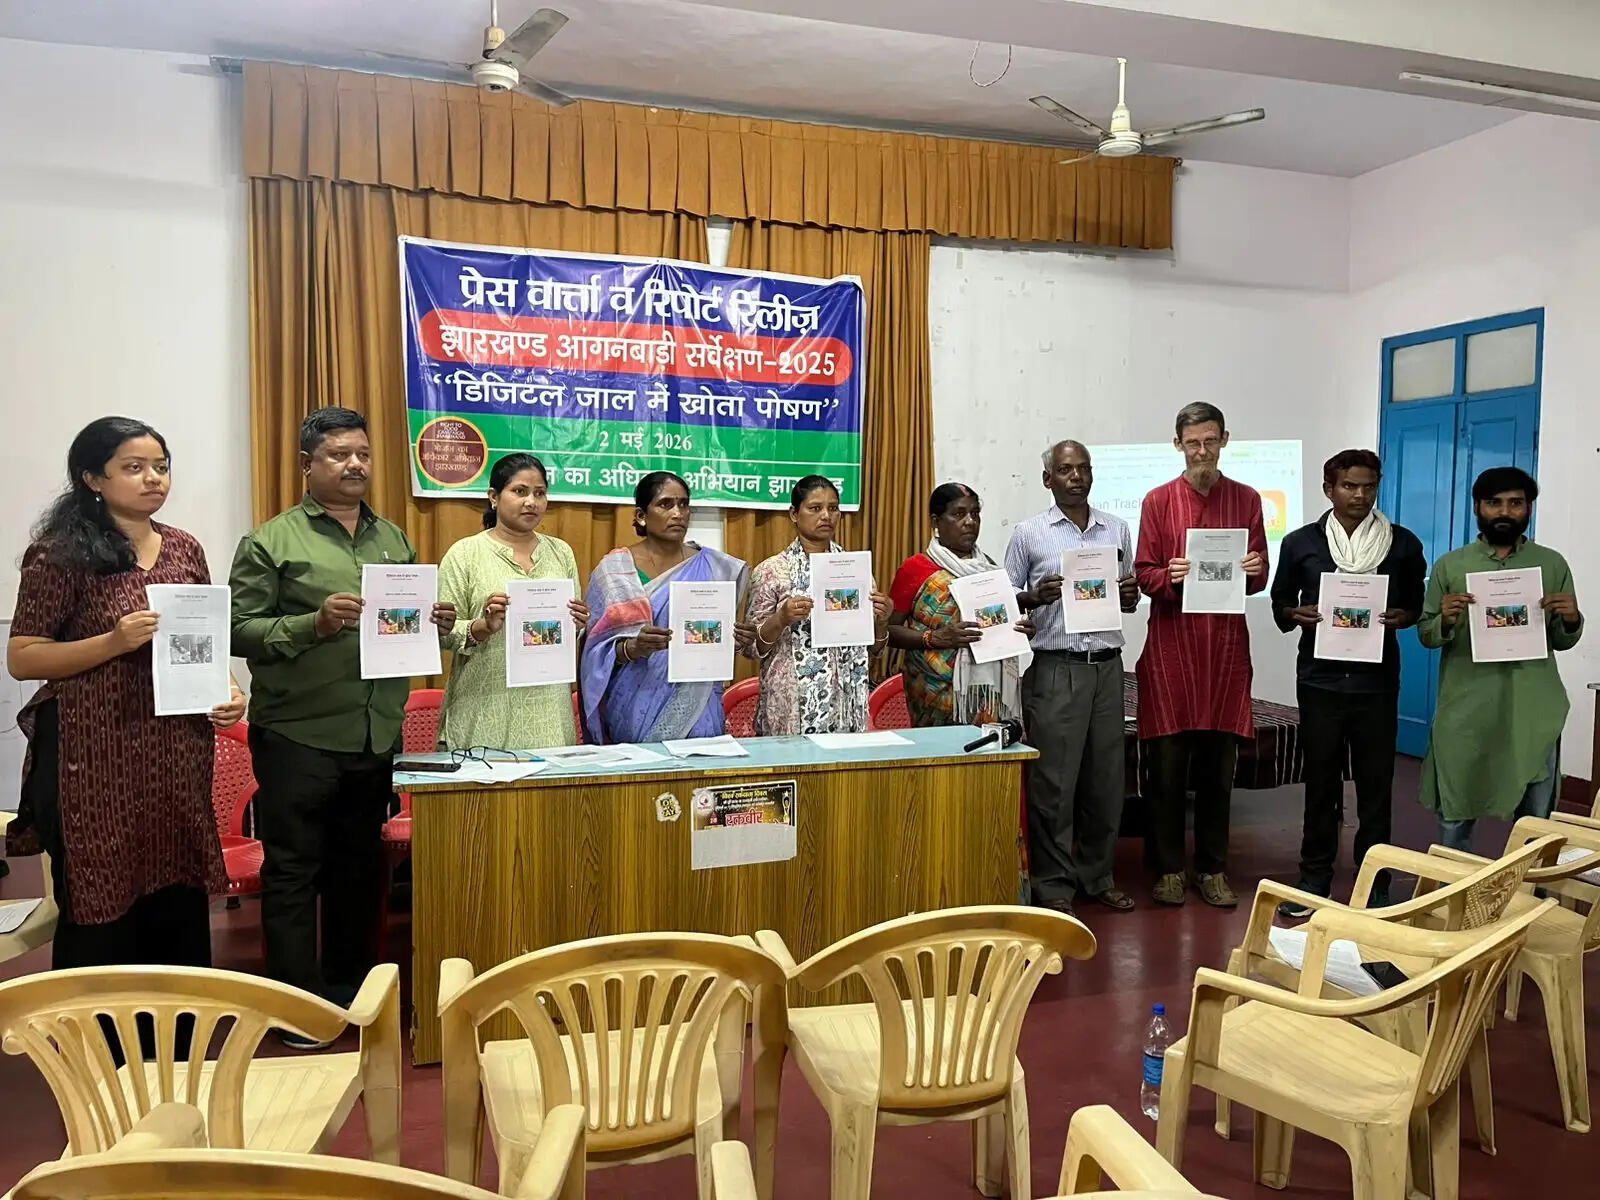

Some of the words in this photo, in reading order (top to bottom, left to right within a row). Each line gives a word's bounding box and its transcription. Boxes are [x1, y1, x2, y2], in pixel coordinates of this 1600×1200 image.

[459, 266, 519, 308] प्रेस
[609, 285, 635, 315] व
[644, 277, 724, 322] रिपोर्ट
[439, 324, 549, 358] झारखण्ड
[556, 327, 677, 370] आंगनबाड़ी
[574, 386, 637, 411] जाल
[645, 382, 670, 412] में
[678, 386, 746, 417] खोता
[599, 431, 609, 447] 2
[620, 426, 645, 451] मई
[654, 432, 693, 451] 2026
[563, 467, 592, 486] का
[683, 466, 762, 493] अभियान
